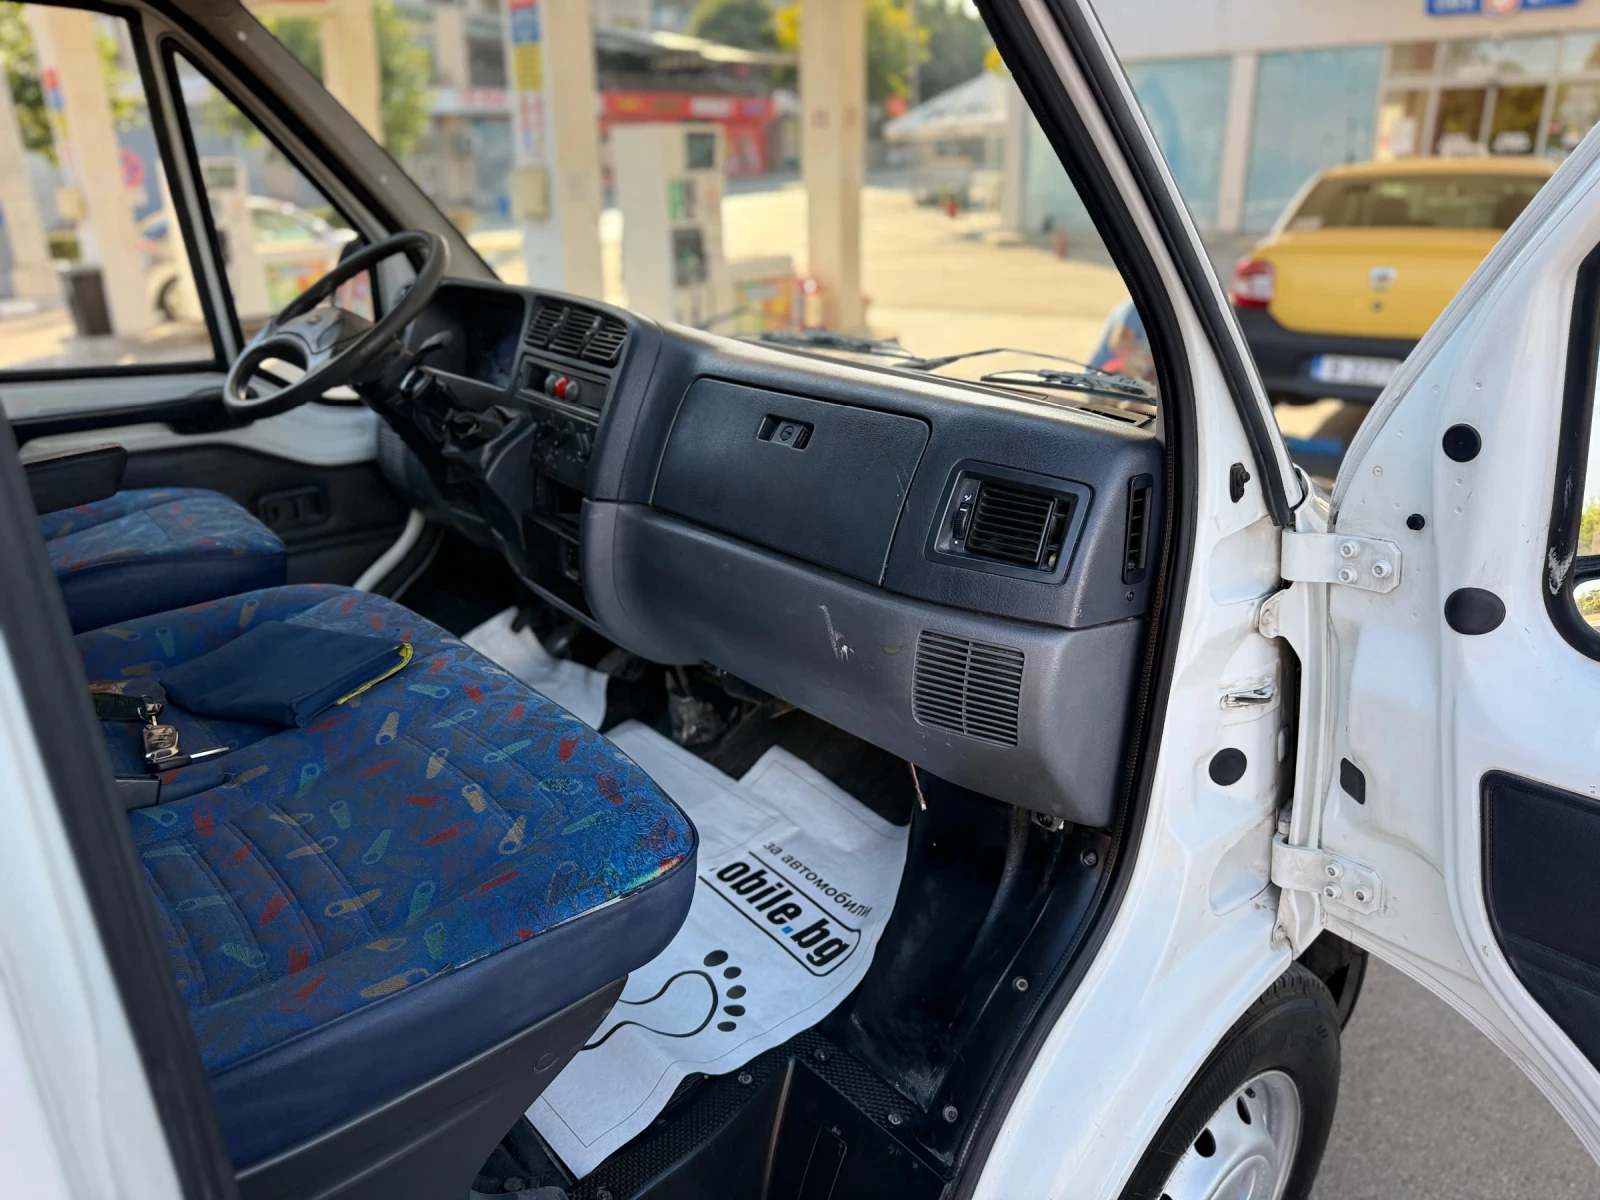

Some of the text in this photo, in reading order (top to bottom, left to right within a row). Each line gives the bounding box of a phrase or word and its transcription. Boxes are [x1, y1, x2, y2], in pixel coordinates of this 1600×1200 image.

[709, 861, 850, 967] obile.bg
[763, 842, 873, 918] за автомобили
